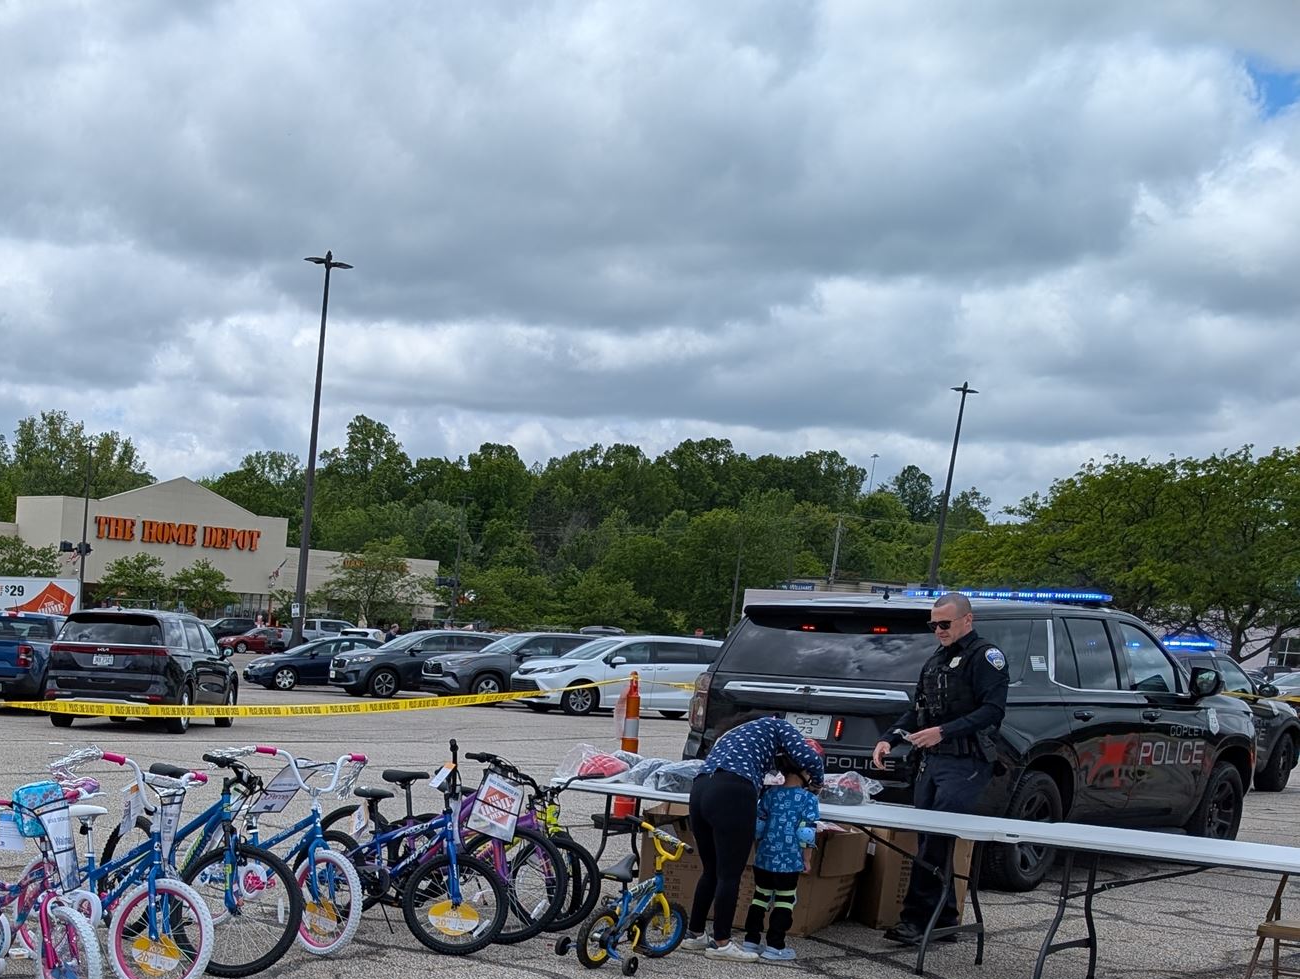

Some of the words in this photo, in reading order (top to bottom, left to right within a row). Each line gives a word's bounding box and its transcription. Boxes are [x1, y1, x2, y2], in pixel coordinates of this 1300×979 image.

[95, 515, 136, 541] THE
[141, 520, 198, 546] HOME
[203, 526, 261, 551] DEPOT
[5, 585, 24, 597] $29
[795, 717, 819, 725] CPD
[799, 726, 813, 734] 73
[1170, 725, 1205, 737] COPLEY
[1138, 741, 1205, 765] POLICE
